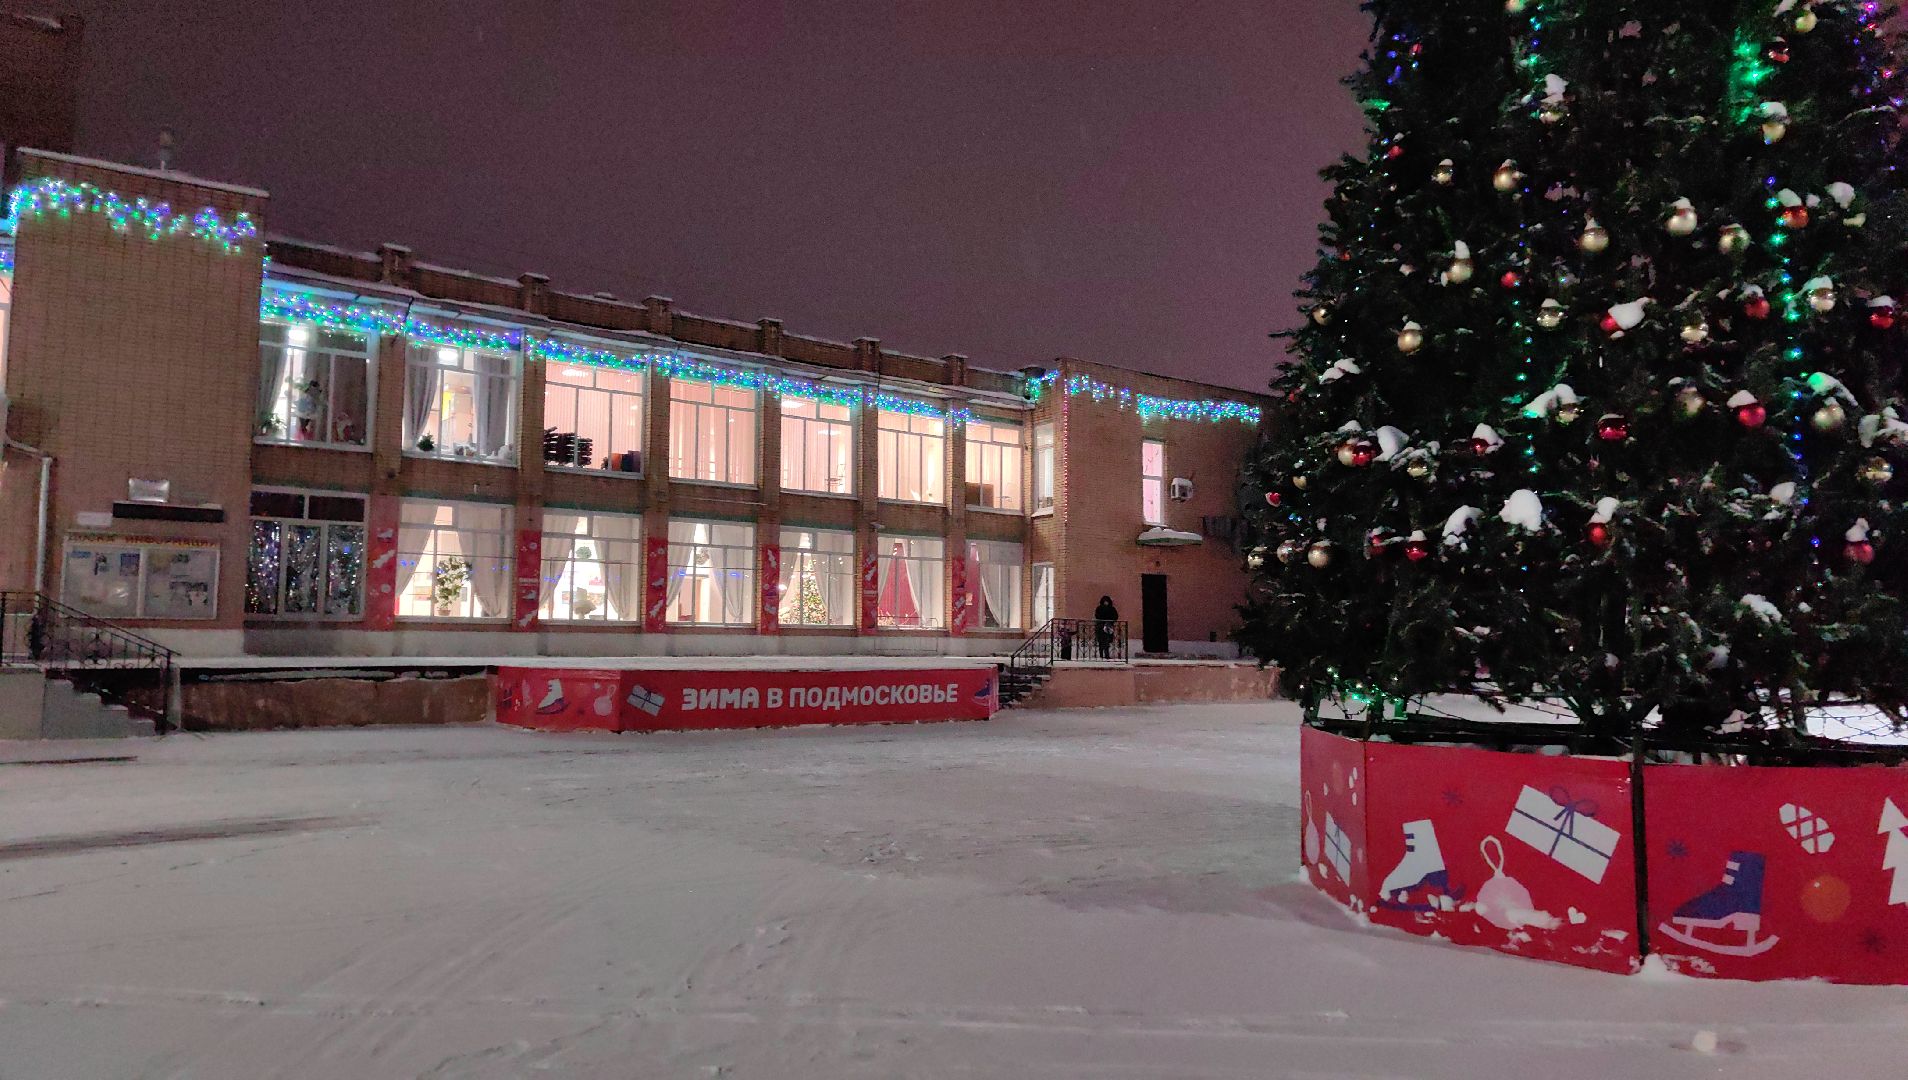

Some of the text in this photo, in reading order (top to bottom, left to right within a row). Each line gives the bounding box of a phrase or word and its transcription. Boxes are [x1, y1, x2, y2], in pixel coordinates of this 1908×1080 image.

[682, 683, 958, 711] ЗИМА В ПОДМОСКОВЬЕ
